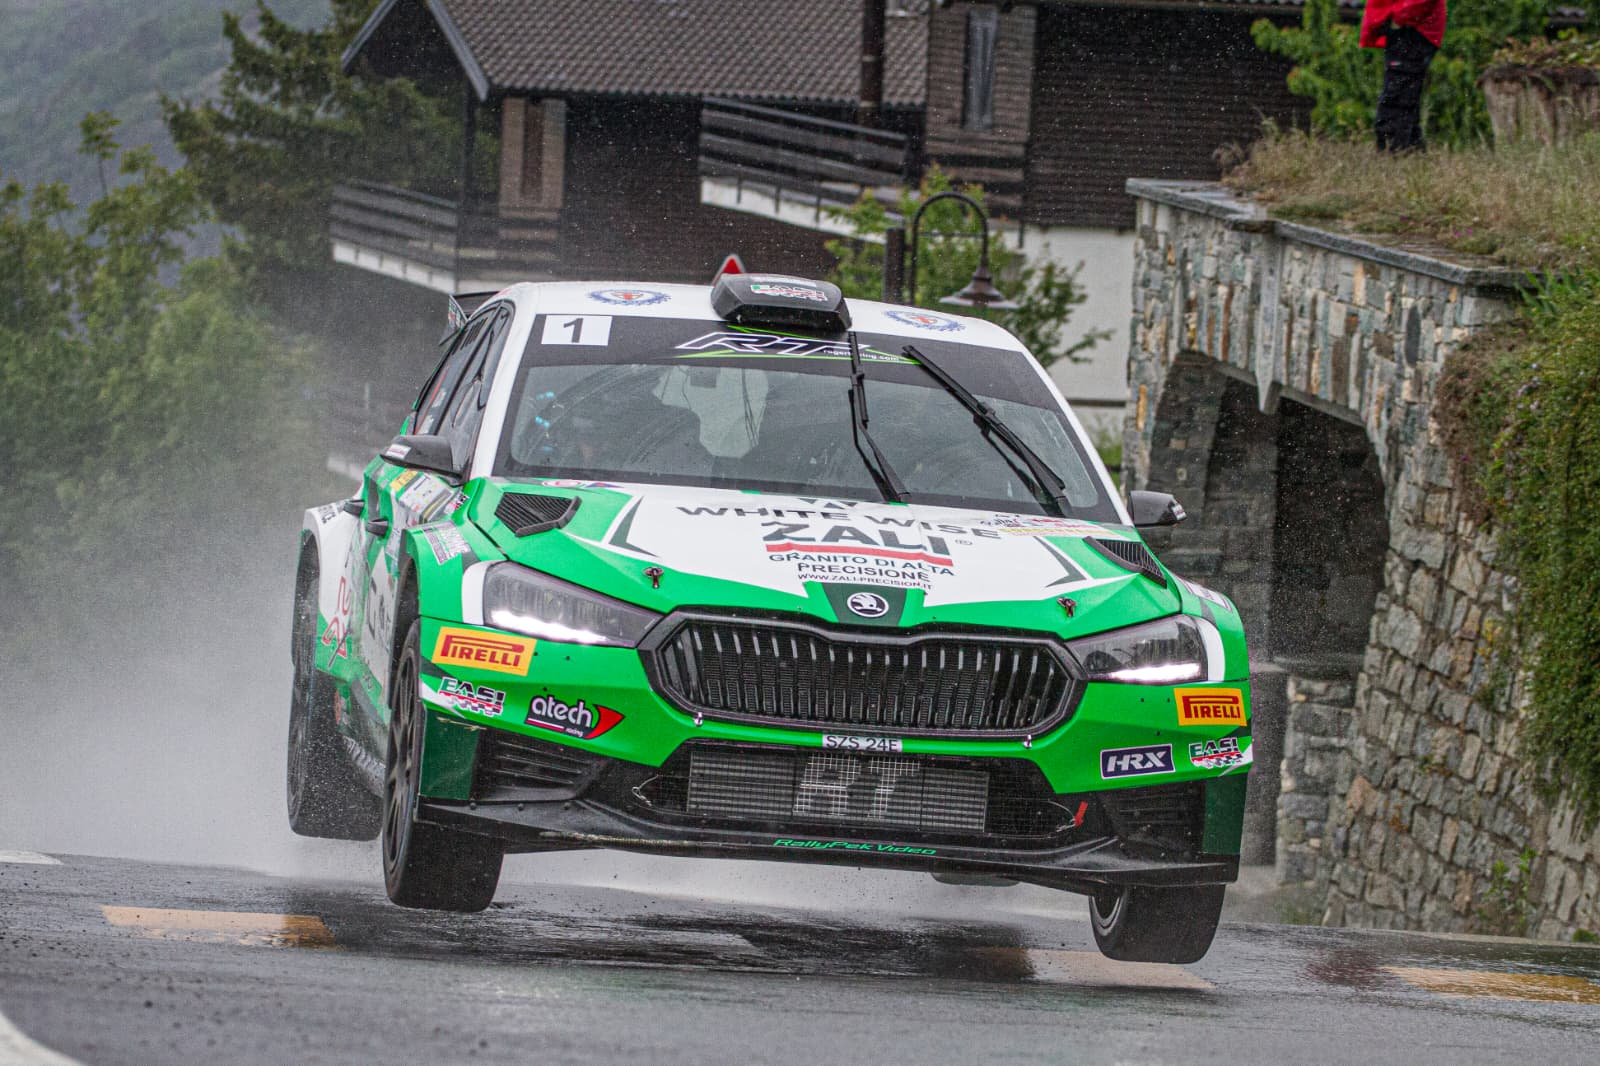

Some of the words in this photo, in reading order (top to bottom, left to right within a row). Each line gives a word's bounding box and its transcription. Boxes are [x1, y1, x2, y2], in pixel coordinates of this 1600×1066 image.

[563, 317, 584, 343] 1
[676, 506, 850, 521] WHITE
[864, 515, 1002, 540] WISE
[760, 521, 951, 556] ZALI
[768, 552, 868, 565] GRANITO
[875, 558, 895, 568] DI
[901, 560, 955, 577] ALTA
[798, 562, 932, 583] PRECISIONE
[440, 634, 525, 668] PIRELLI
[439, 676, 505, 706] EASI
[530, 696, 593, 728] atech
[1182, 695, 1241, 719] PIRELLI
[826, 735, 860, 751] SZS
[1189, 736, 1241, 759] EASI
[1106, 750, 1167, 773] HRX
[773, 838, 873, 850] RallyPek
[877, 844, 937, 855] Video
